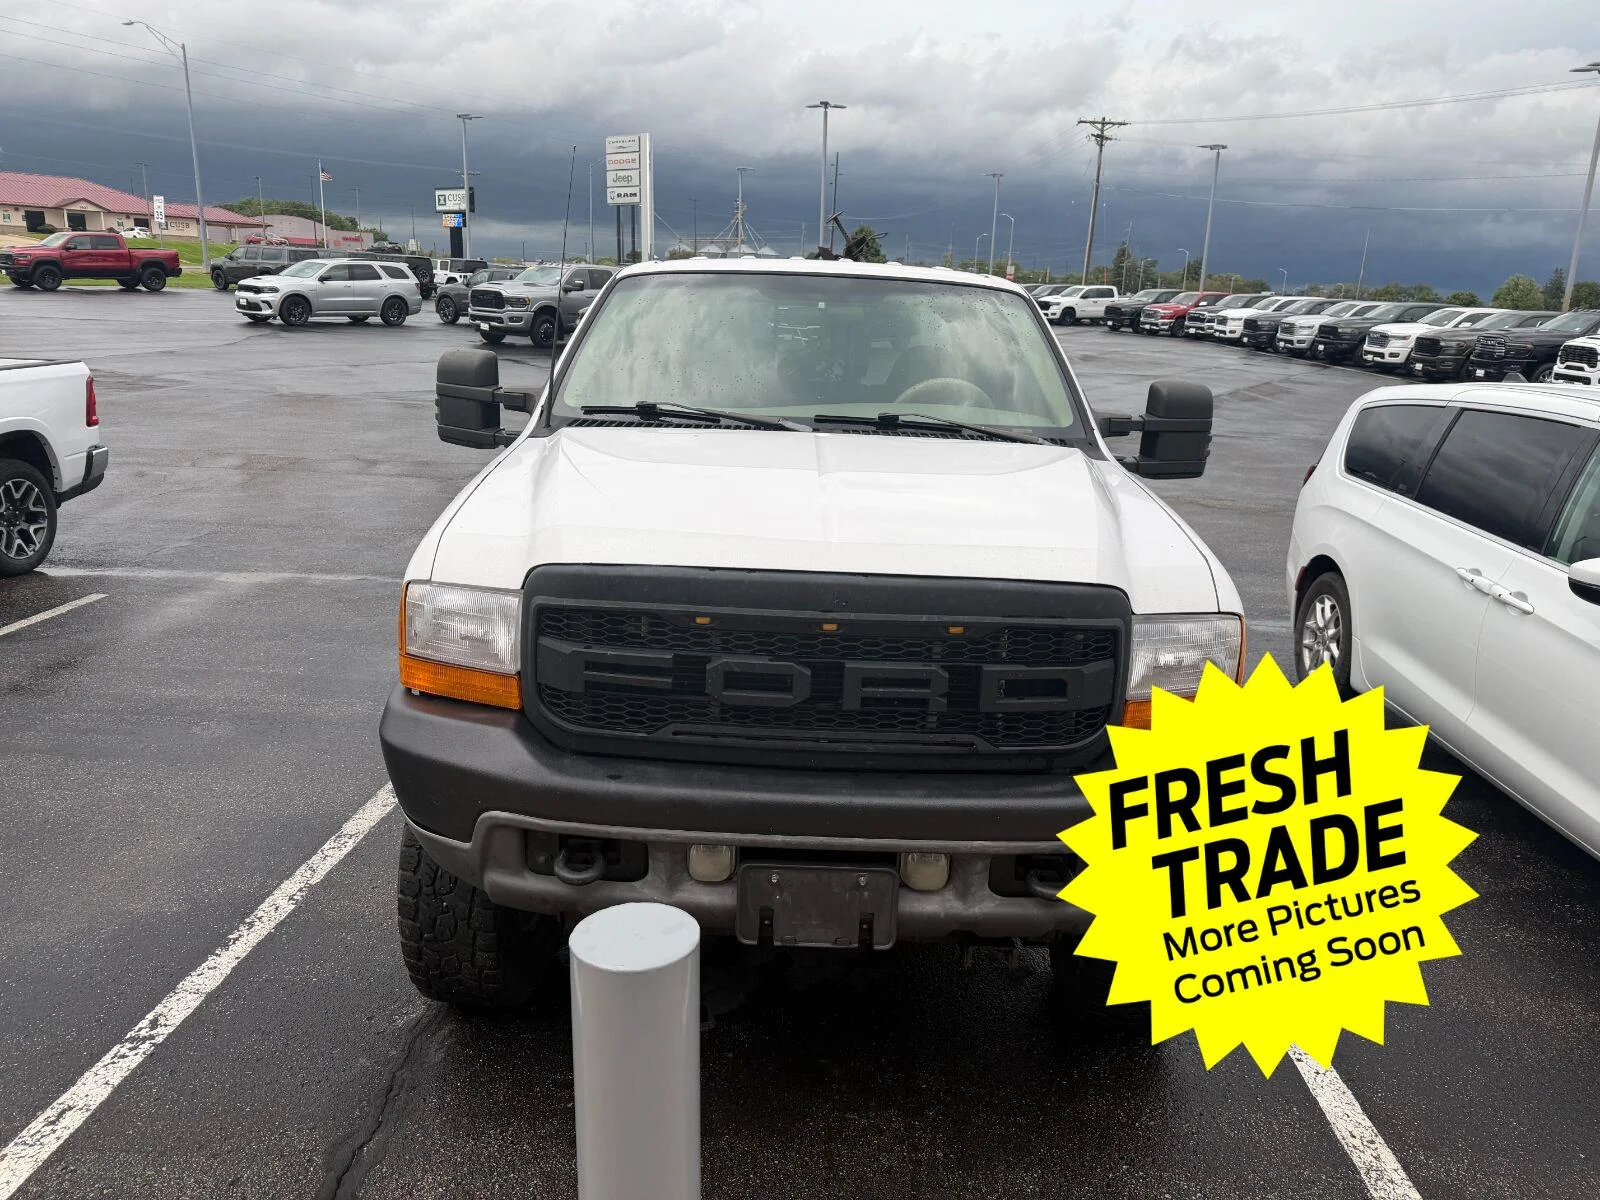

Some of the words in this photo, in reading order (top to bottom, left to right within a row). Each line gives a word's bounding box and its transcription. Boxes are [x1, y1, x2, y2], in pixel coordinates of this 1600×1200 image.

[608, 157, 637, 165] DODGE
[612, 172, 633, 184] Jeep
[155, 210, 164, 220] 35
[169, 221, 190, 229] CUSB
[537, 635, 1115, 712] FORD
